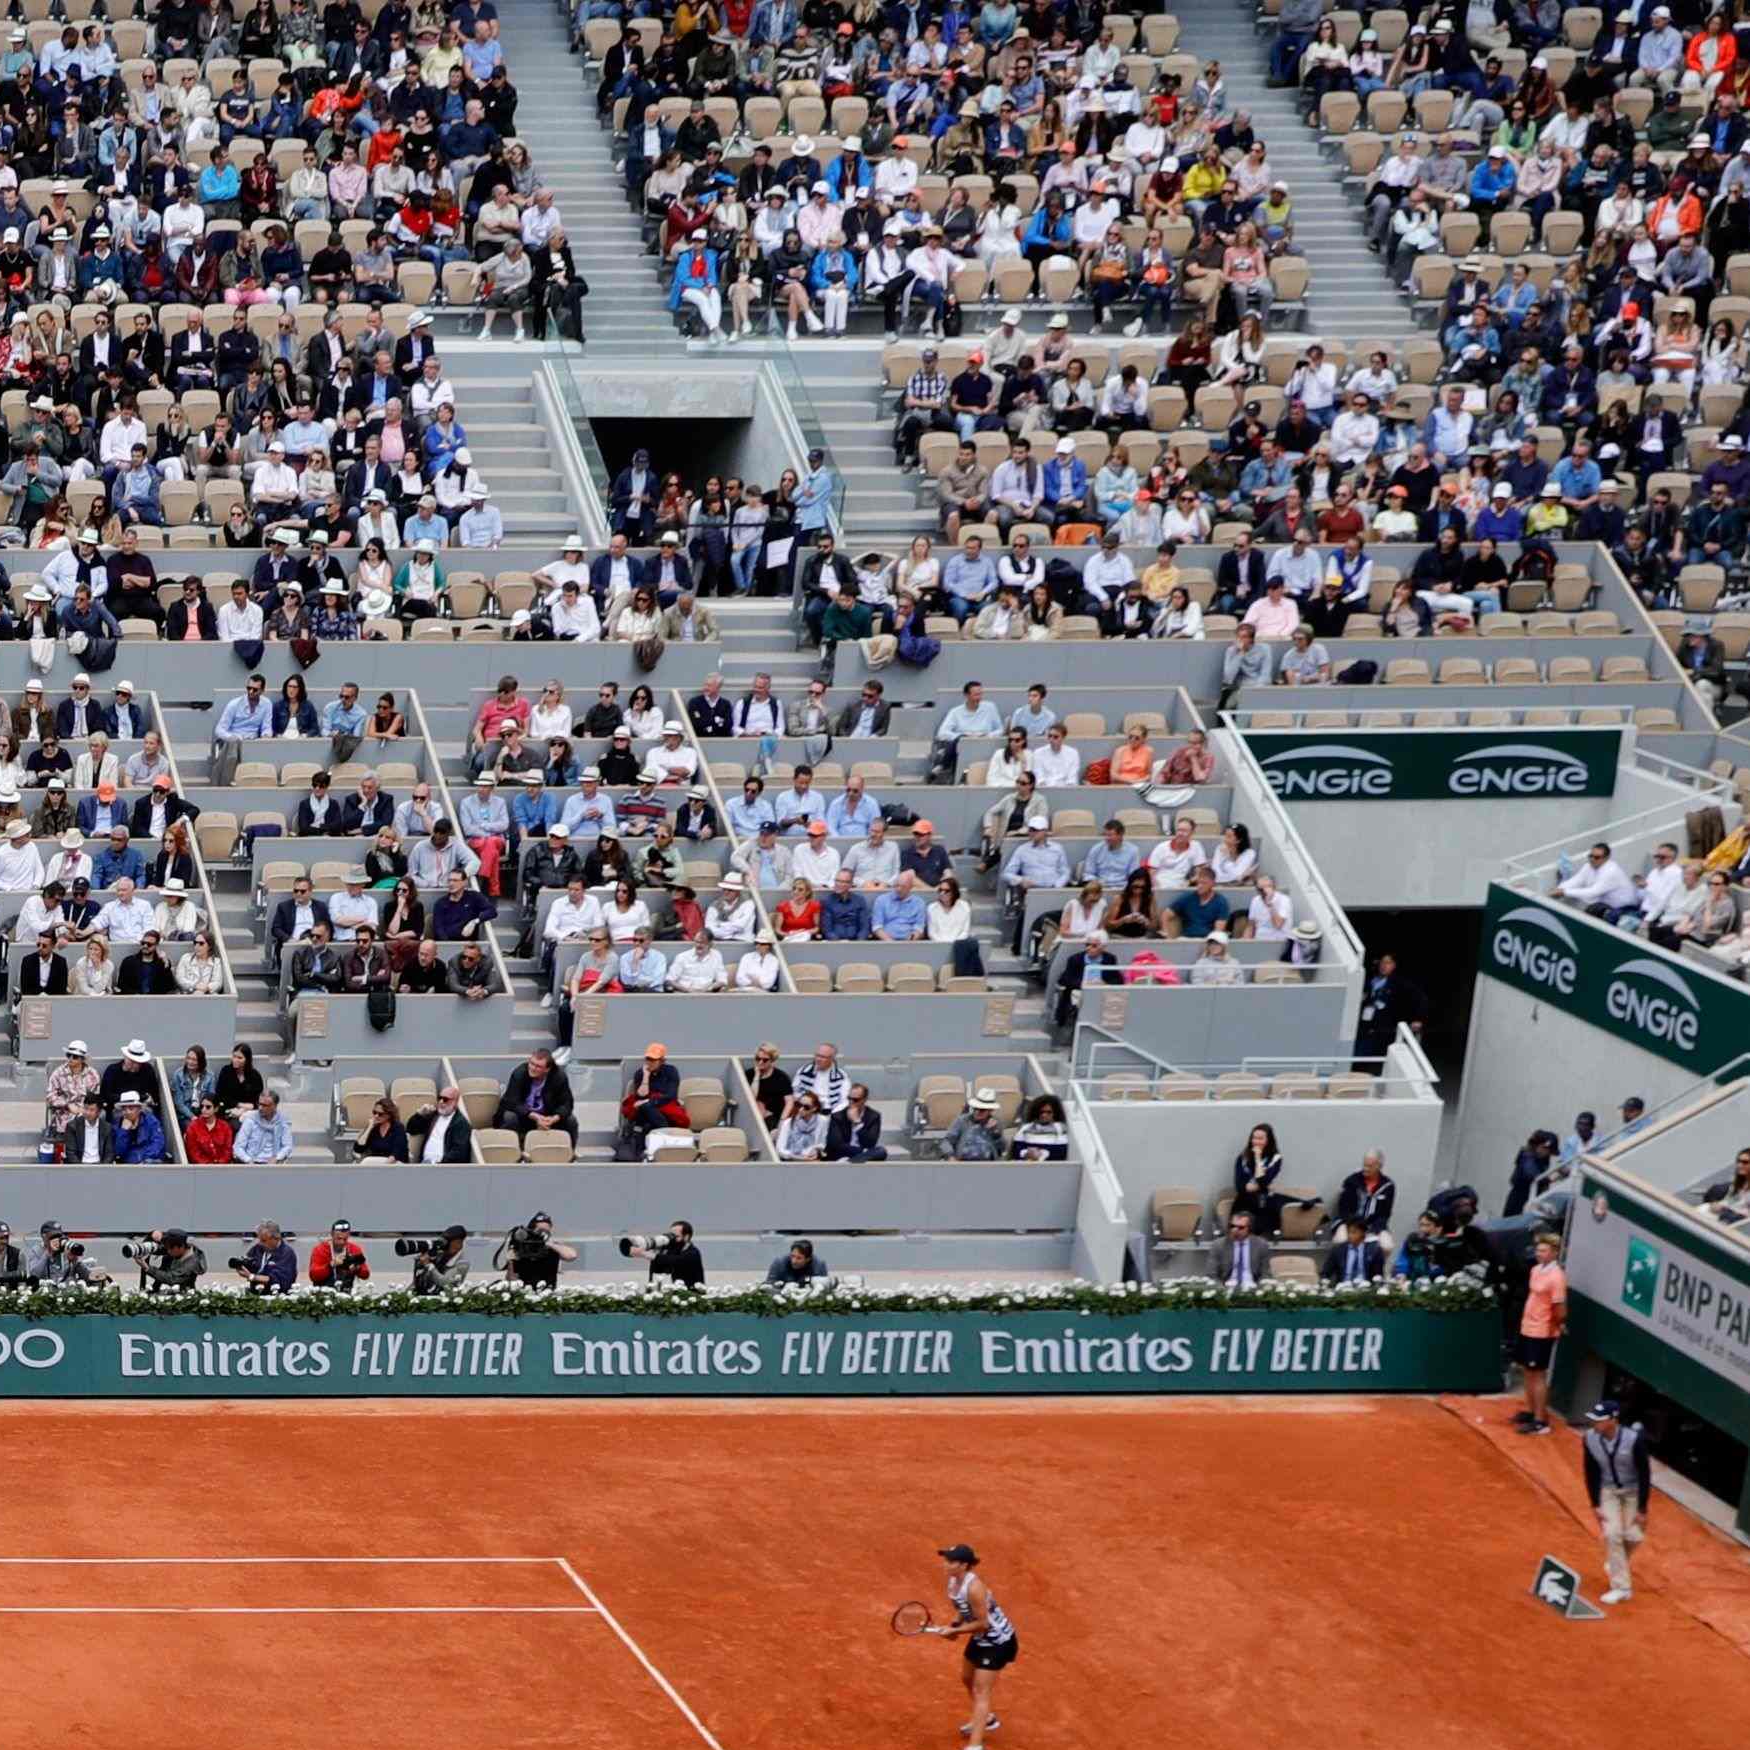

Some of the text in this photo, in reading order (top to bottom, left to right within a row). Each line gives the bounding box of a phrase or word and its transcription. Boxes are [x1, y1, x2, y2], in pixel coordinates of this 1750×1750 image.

[1664, 1261, 1713, 1318] BNP
[118, 1332, 523, 1377] Emirates FLY BETTER
[550, 1331, 954, 1376] Emirates FLY BETTER
[980, 1328, 1384, 1375] Emirates FLY BETTER
